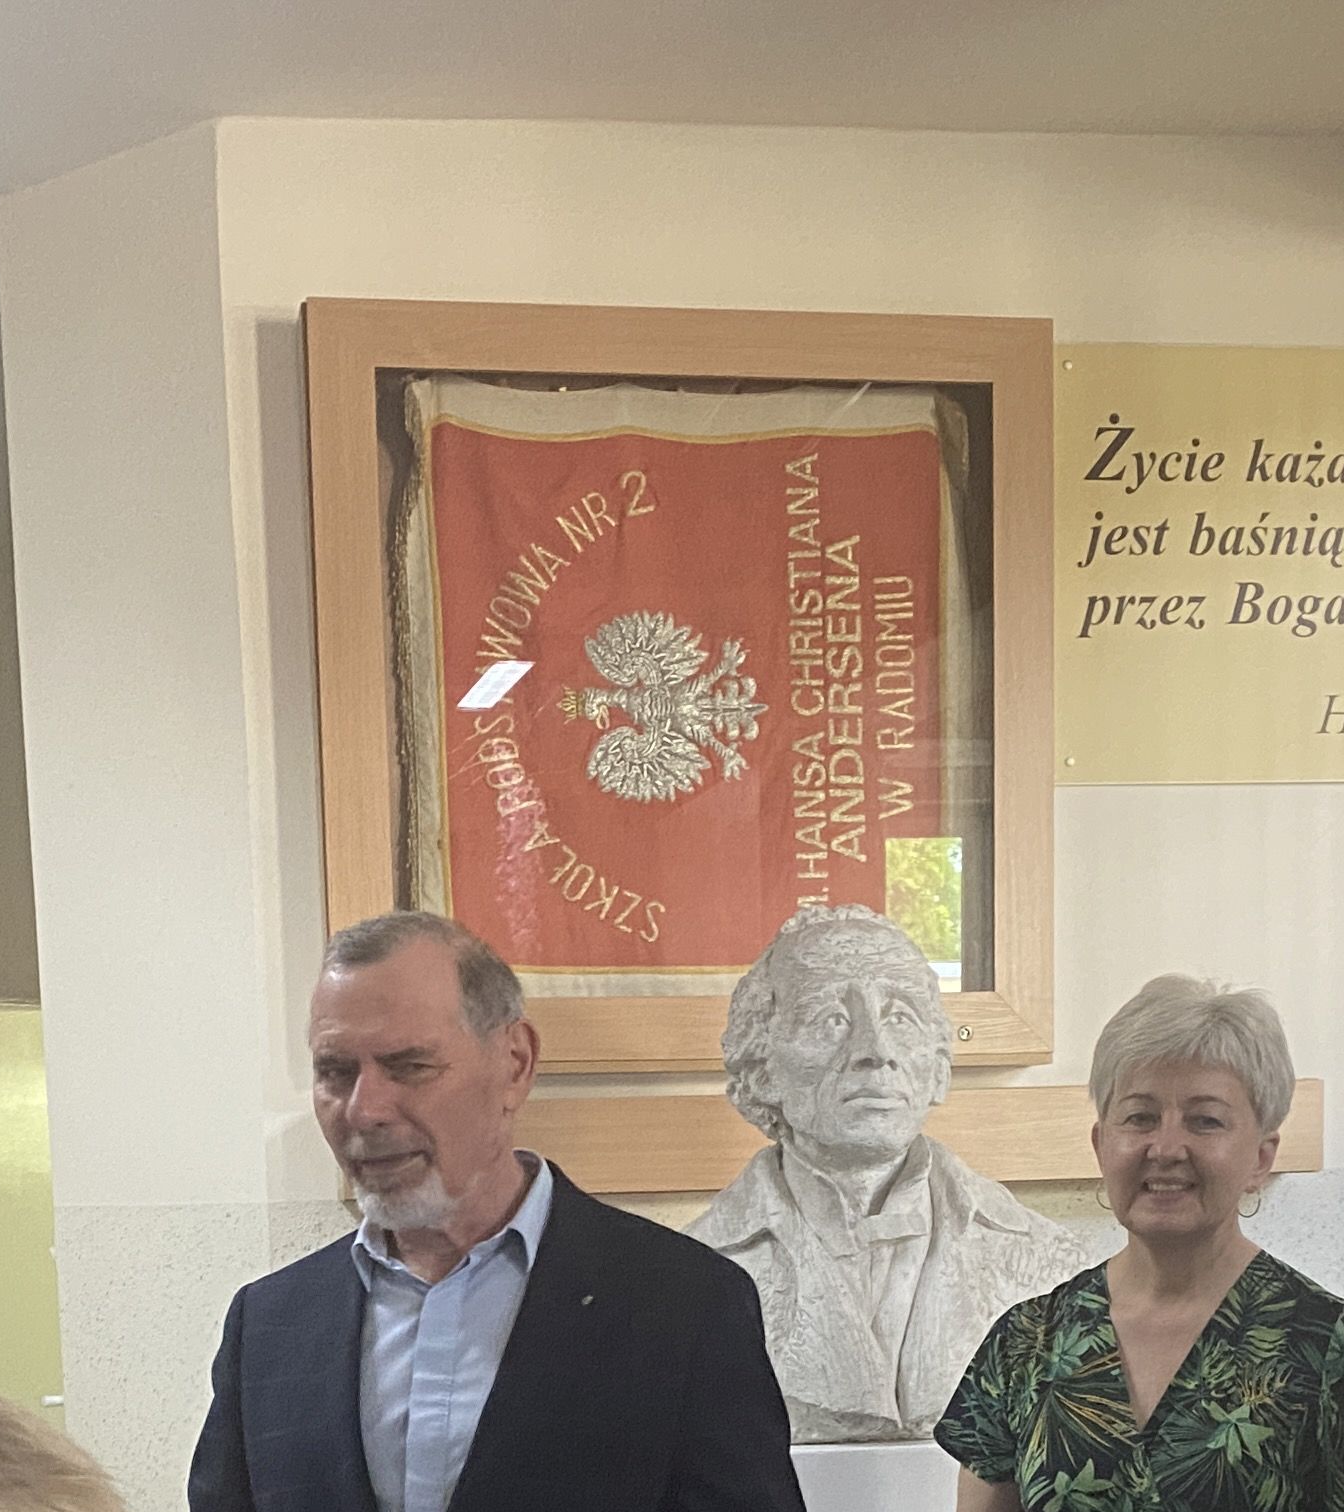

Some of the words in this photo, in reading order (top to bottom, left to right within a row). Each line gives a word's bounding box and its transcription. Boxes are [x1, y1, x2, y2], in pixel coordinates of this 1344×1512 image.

[620, 470, 655, 516] 2
[1084, 413, 1225, 494] Życie
[556, 492, 619, 553] NR
[1078, 512, 1169, 567] jest
[1189, 512, 1344, 567] baśnią
[785, 453, 824, 716] CHRISTIANA
[1077, 589, 1206, 638] przez
[474, 543, 571, 817] PODSWOWA
[825, 534, 867, 863] ANDERSENA
[873, 576, 915, 749] RADOMIU
[792, 731, 829, 878] HANSA
[878, 777, 914, 820] W
[523, 820, 666, 942] SZKOŁA
